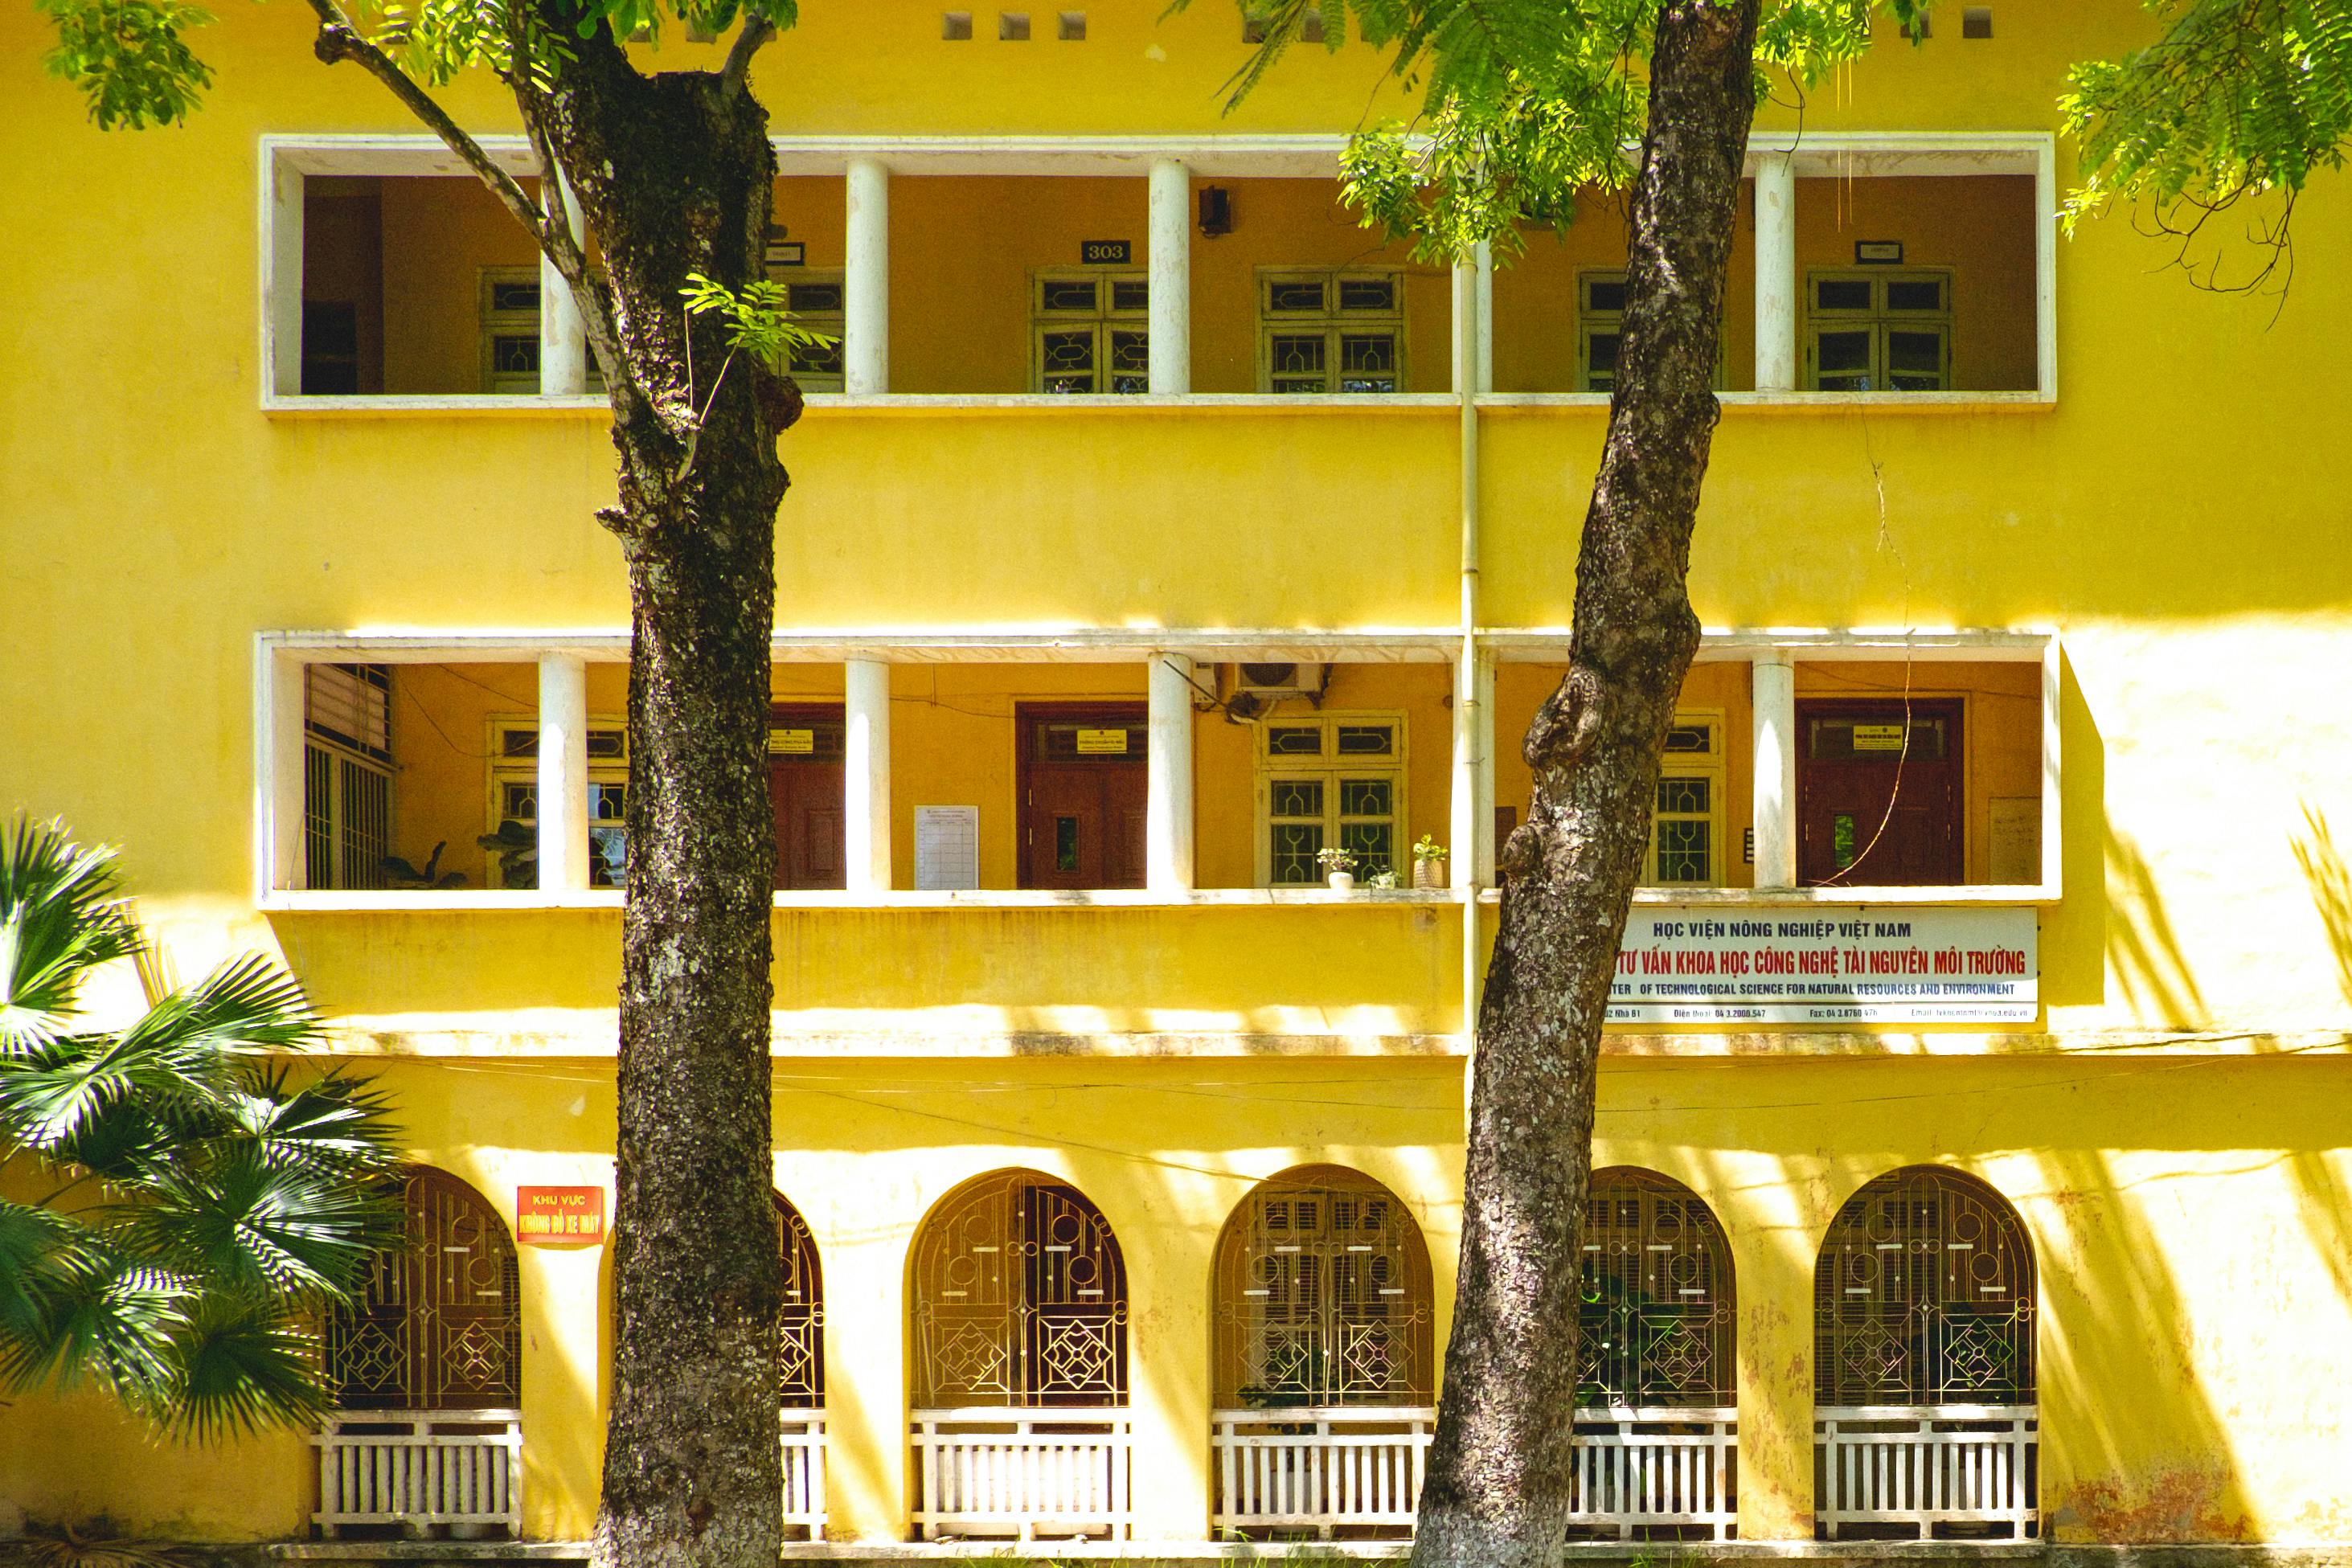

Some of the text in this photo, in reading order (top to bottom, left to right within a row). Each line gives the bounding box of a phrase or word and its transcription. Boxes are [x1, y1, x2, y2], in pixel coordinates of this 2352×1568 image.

[1088, 245, 1123, 259] 303
[1653, 919, 1911, 940] HỌC VIỆN NÔNG NGHIỆP VIỆT NAM
[1619, 944, 2026, 978] TƯ VẤN KHOA HỌC CÔNG NGHỆ TÀI NGUYÊN MÔI TRƯỜNG
[1610, 983, 2014, 995] TER OF TECHNOLOGICAL SCIENCE FOR NATURAL RESOURCES AND ENVIRONMENT
[1809, 1009, 1825, 1017] Fax:
[532, 1195, 586, 1207] KHU VỰC
[519, 1210, 551, 1234] KHÔNG
[565, 1214, 578, 1234] XE
[580, 1211, 600, 1234] MÁY
